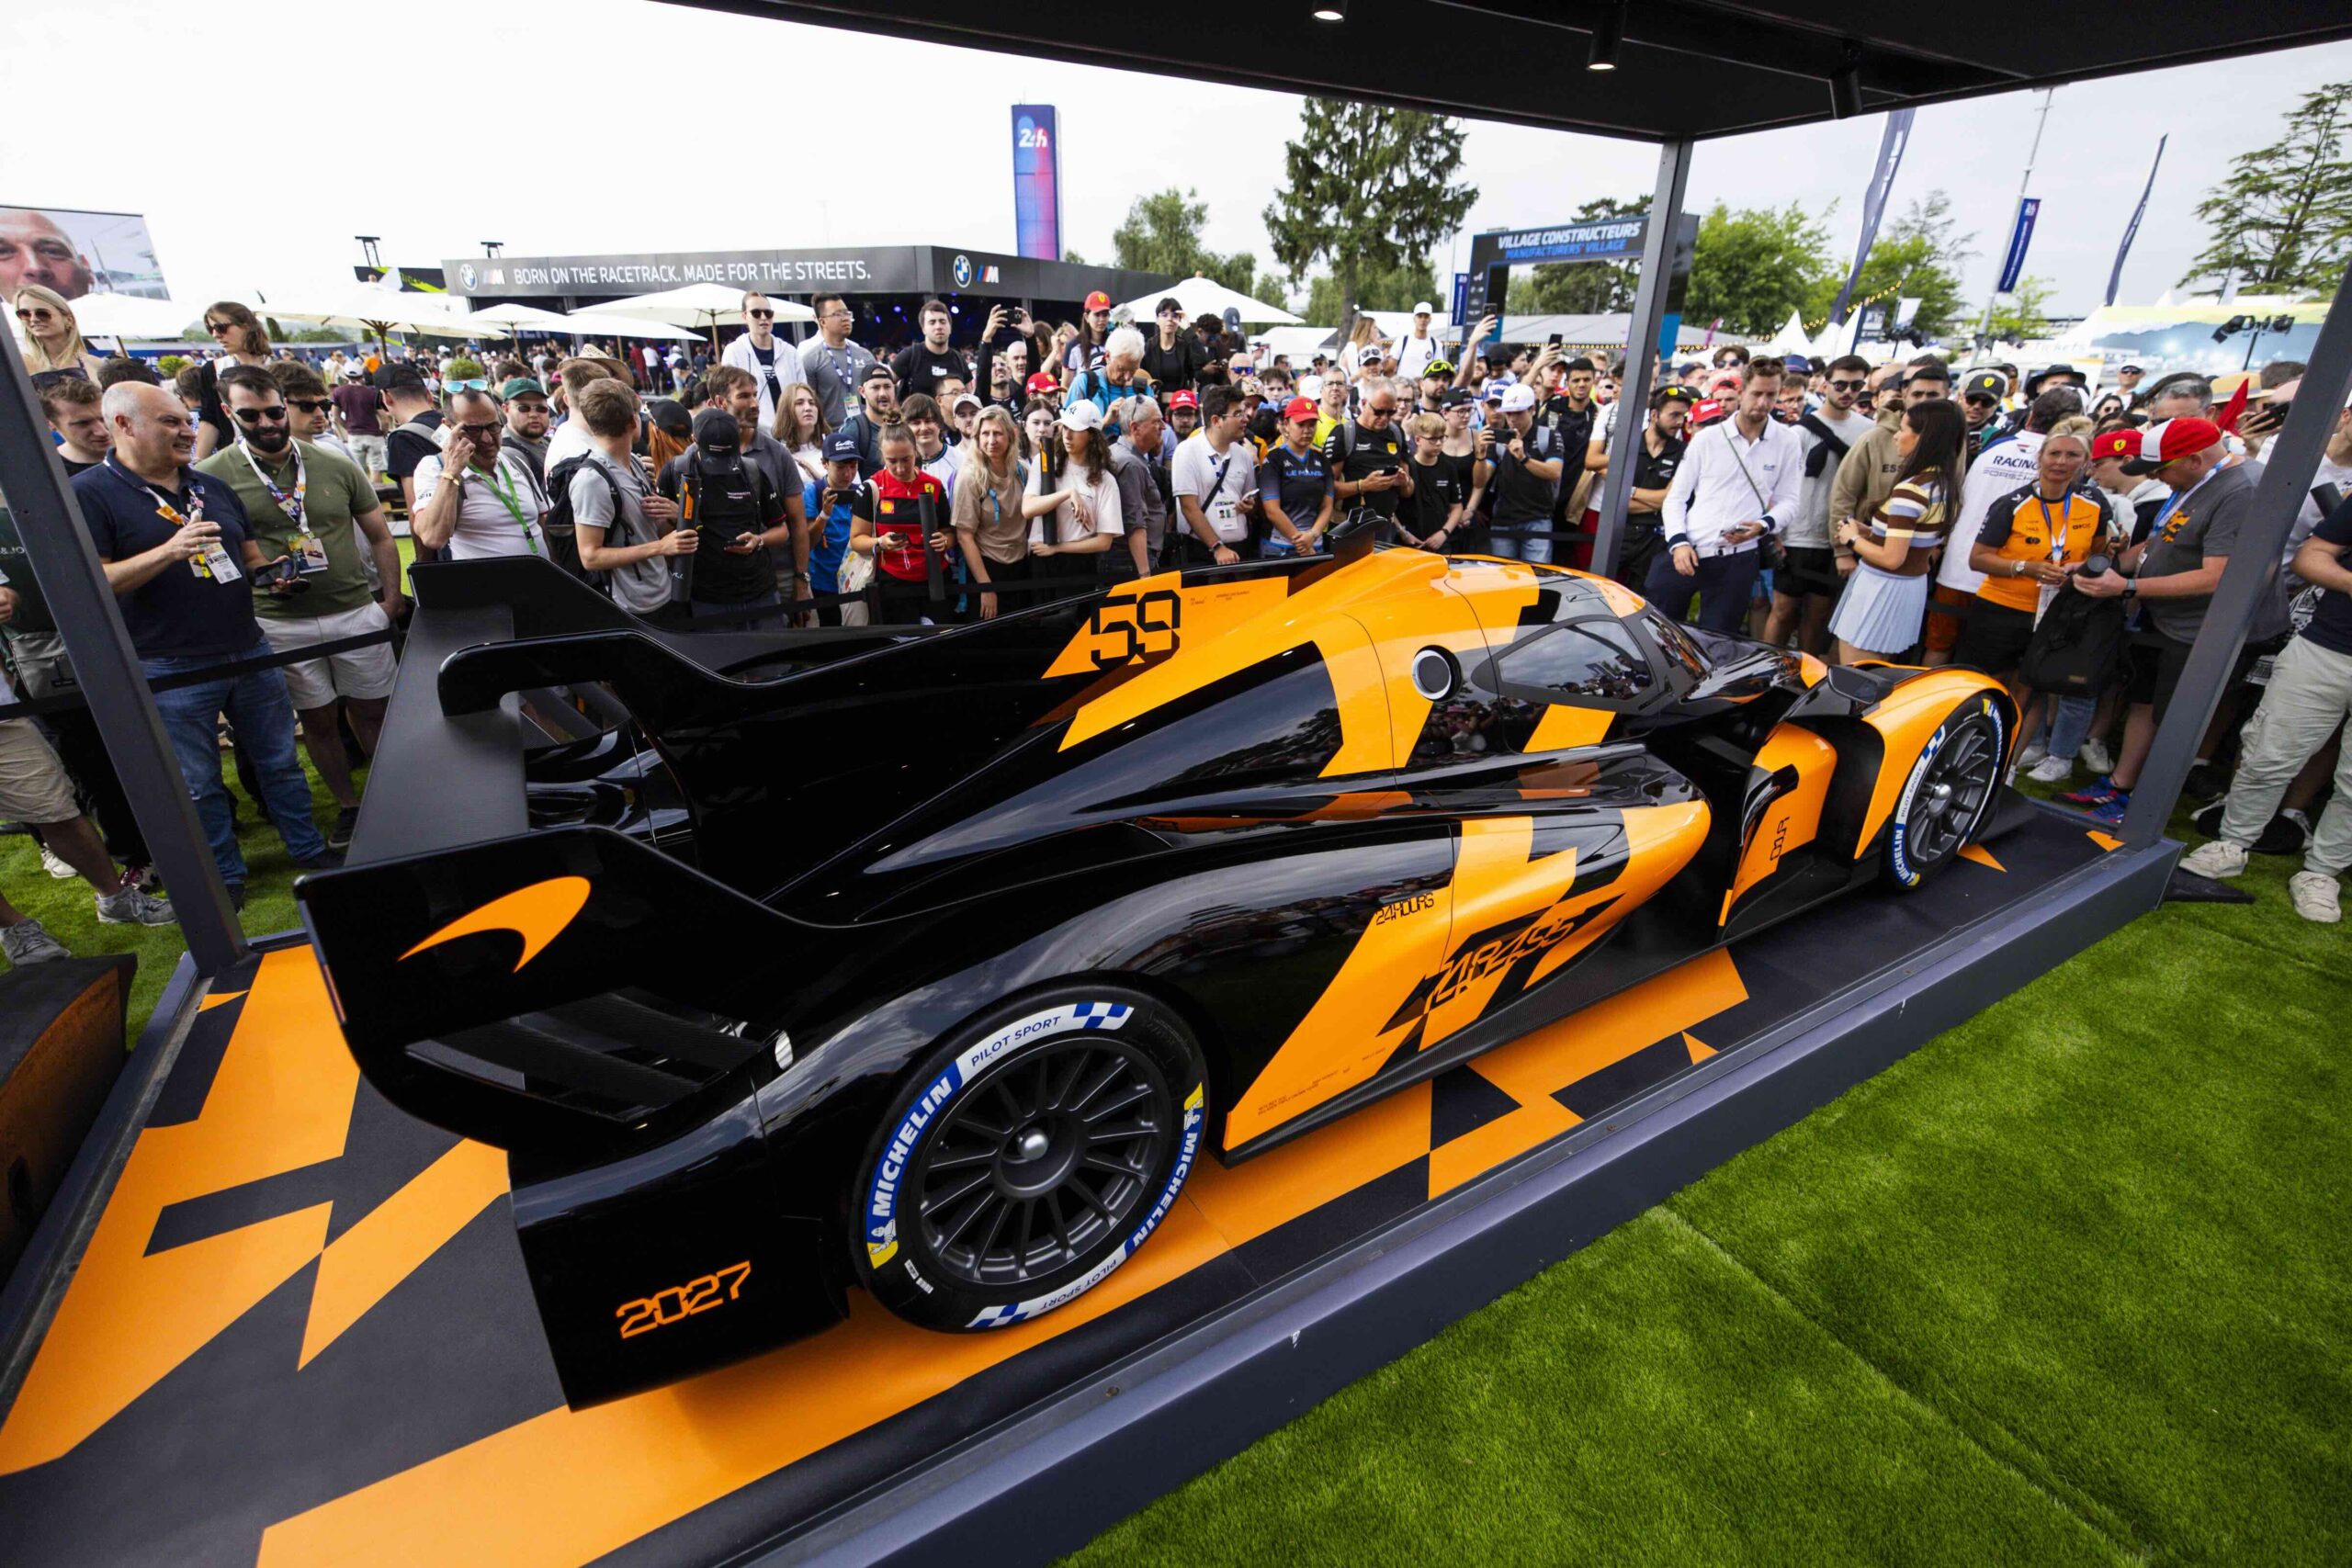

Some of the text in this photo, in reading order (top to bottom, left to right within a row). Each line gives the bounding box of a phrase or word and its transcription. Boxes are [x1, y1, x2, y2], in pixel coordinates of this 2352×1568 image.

[1498, 221, 1643, 250] VILLAGE CONSTRUCTEURS
[1585, 238, 1627, 253] VILLAGE
[514, 268, 549, 285] BORN
[550, 267, 569, 284] ON
[570, 266, 597, 284] THE
[599, 265, 682, 283] RACETRACK.
[684, 264, 726, 282] MADE
[728, 263, 758, 281] FOR
[760, 262, 793, 280] THE
[795, 260, 872, 279] STREETS.
[1091, 589, 1181, 671] 59
[1894, 829, 1911, 880] MICHELIN
[971, 1016, 1061, 1067] PILOT SPORT
[872, 1077, 954, 1217] MICHELIN
[1131, 1132, 1198, 1247] MICHELIN
[616, 1259, 752, 1339] 2027
[1039, 1259, 1116, 1311] PILOT SPORT
